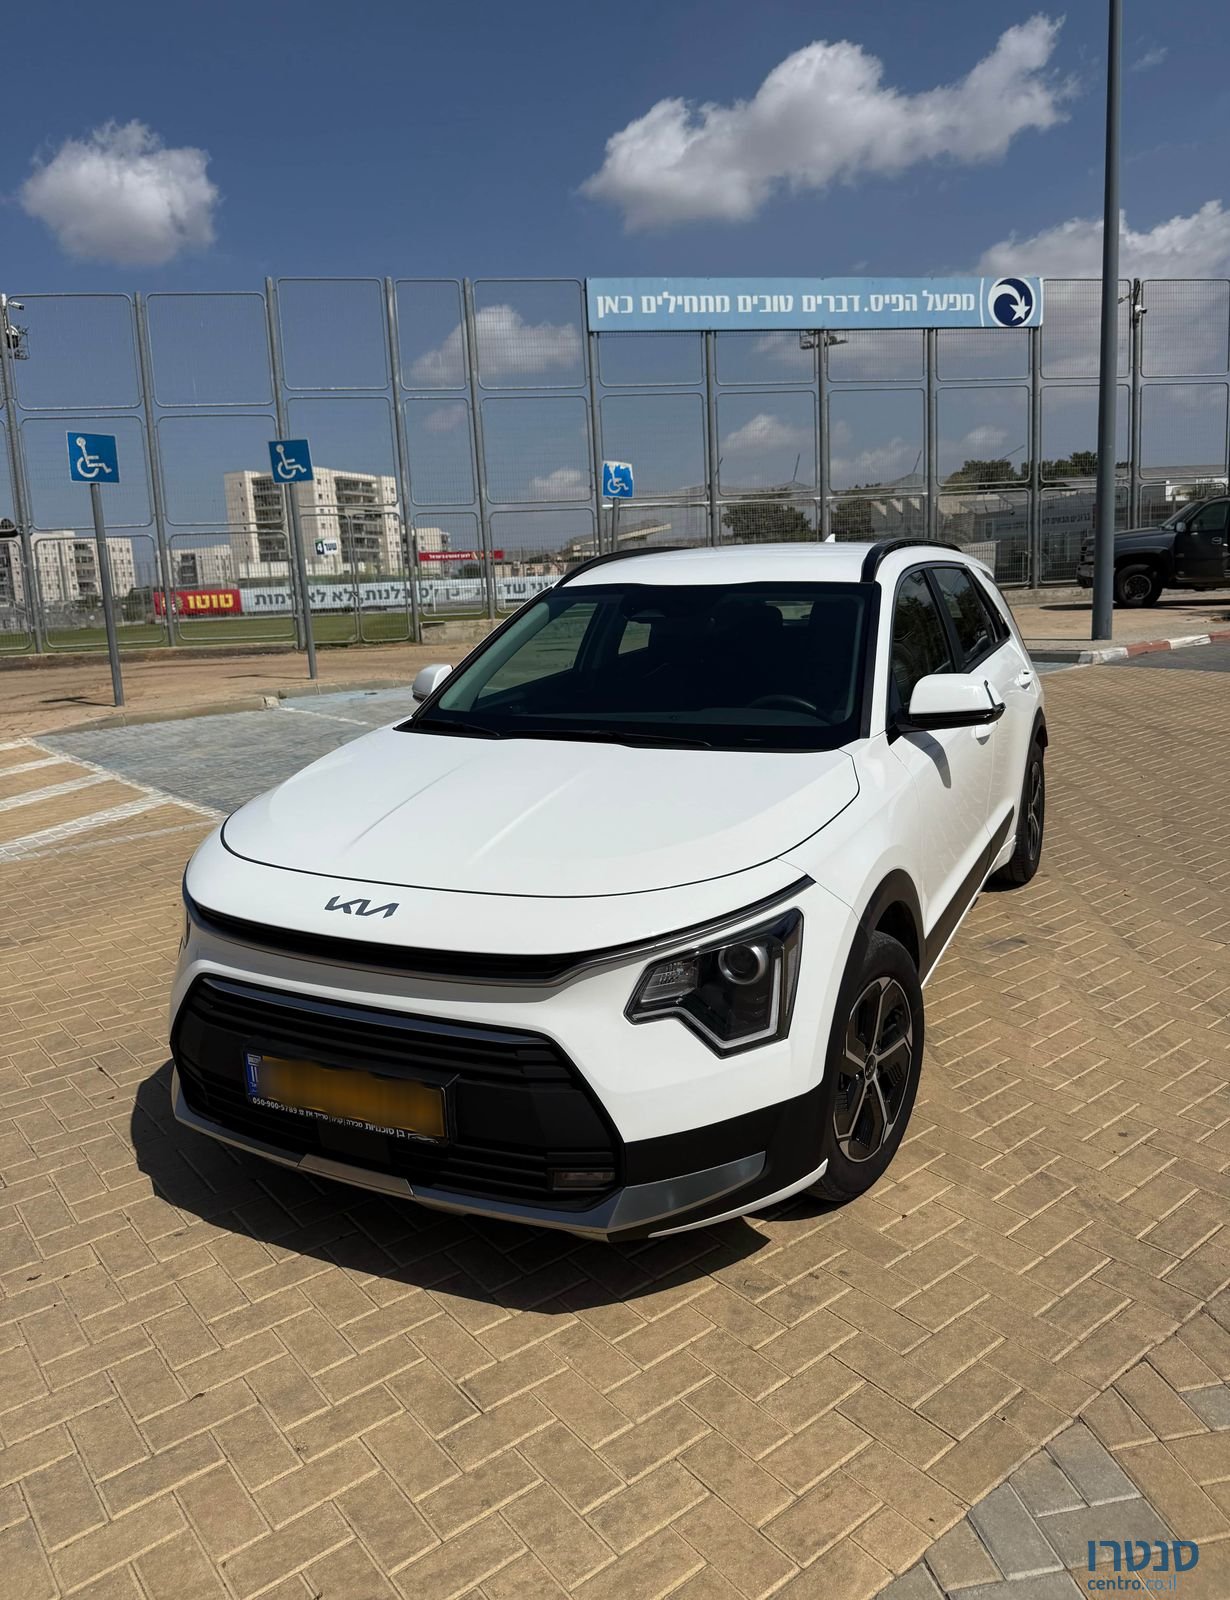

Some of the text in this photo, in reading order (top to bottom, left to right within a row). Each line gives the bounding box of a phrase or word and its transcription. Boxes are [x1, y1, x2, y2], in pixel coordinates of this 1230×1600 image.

[597, 295, 634, 319] כאן
[641, 291, 730, 314] מתחילים
[737, 294, 794, 313] טובים
[923, 289, 975, 312] מפעל
[187, 593, 234, 609] טוטו
[254, 589, 327, 605] לאימות
[324, 895, 399, 919] KIA
